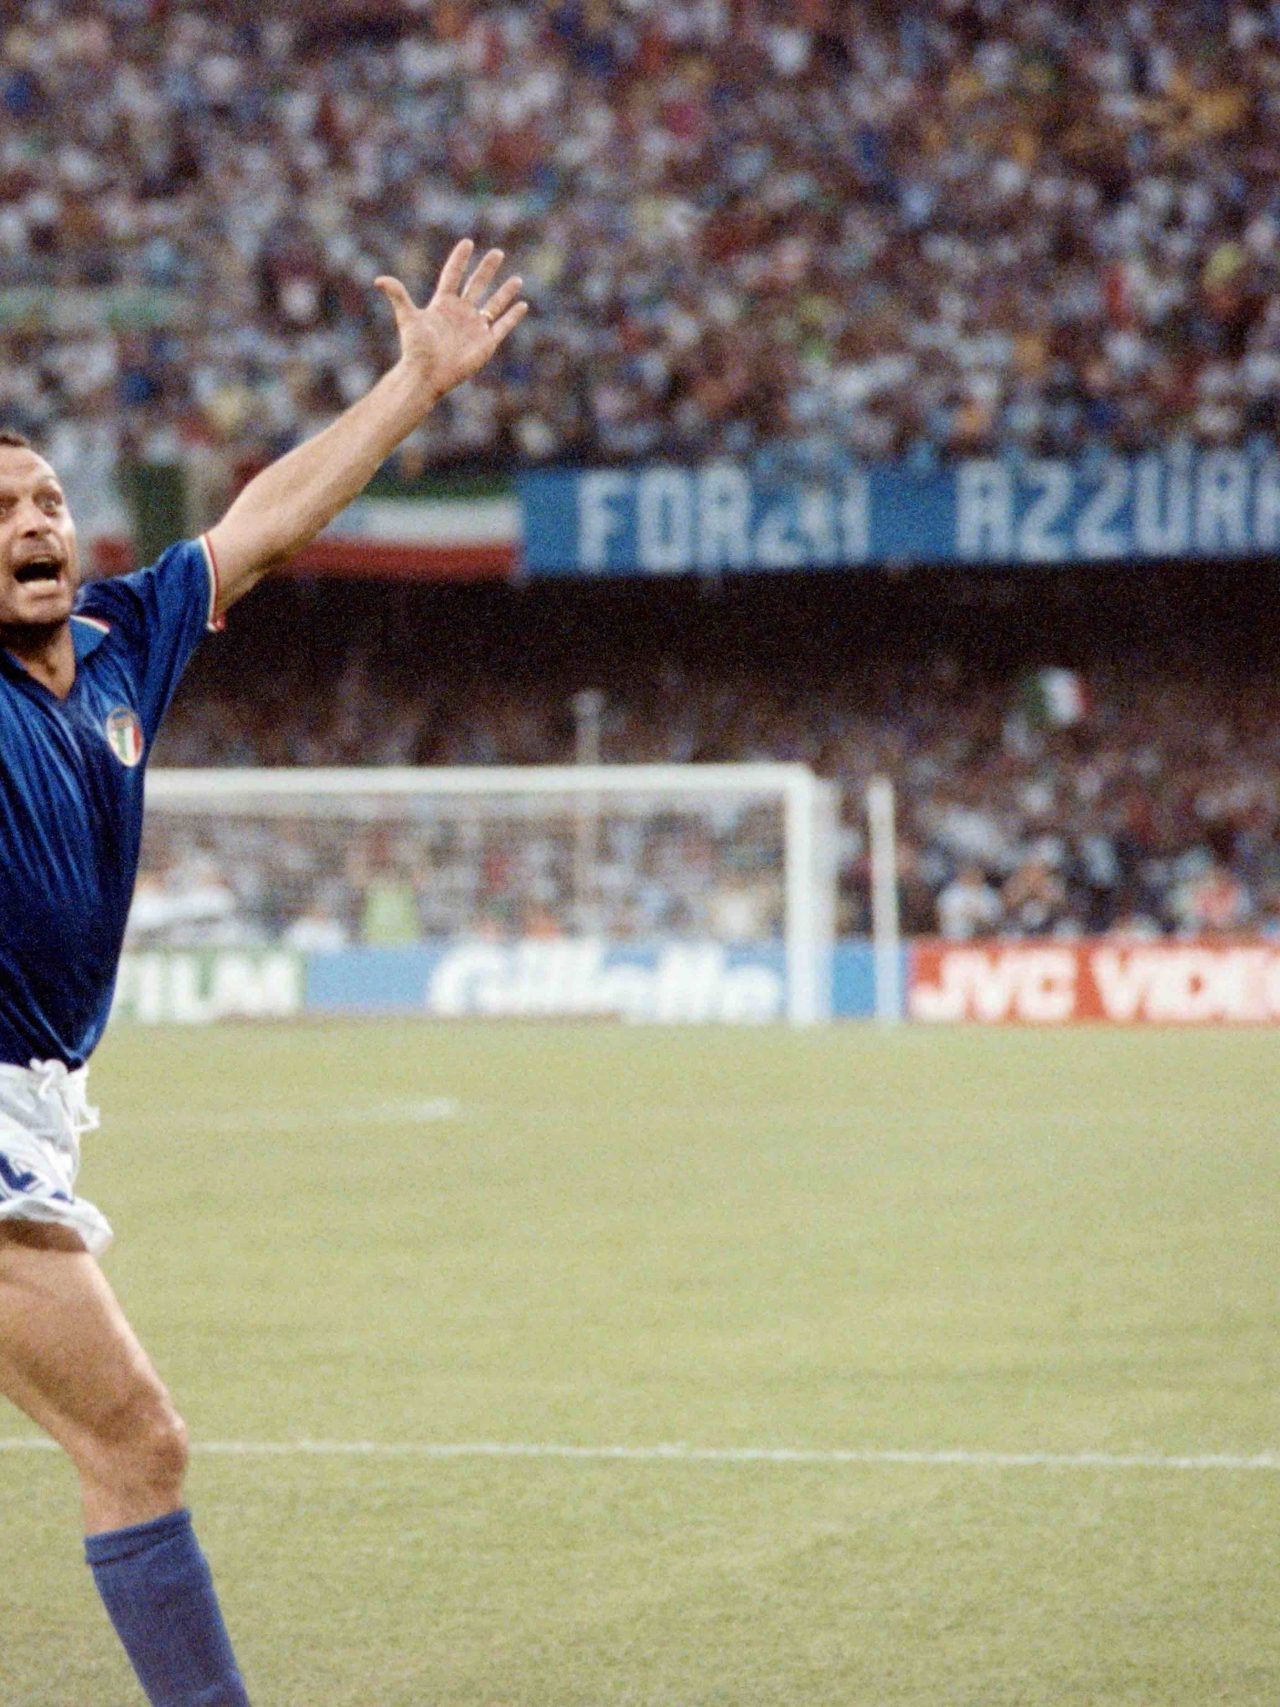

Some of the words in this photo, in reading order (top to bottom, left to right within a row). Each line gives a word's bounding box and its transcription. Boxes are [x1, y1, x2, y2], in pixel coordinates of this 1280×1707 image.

[428, 938, 782, 1026] Gillette
[910, 949, 1078, 1020] JVC
[1090, 947, 1280, 1020] VIDE
